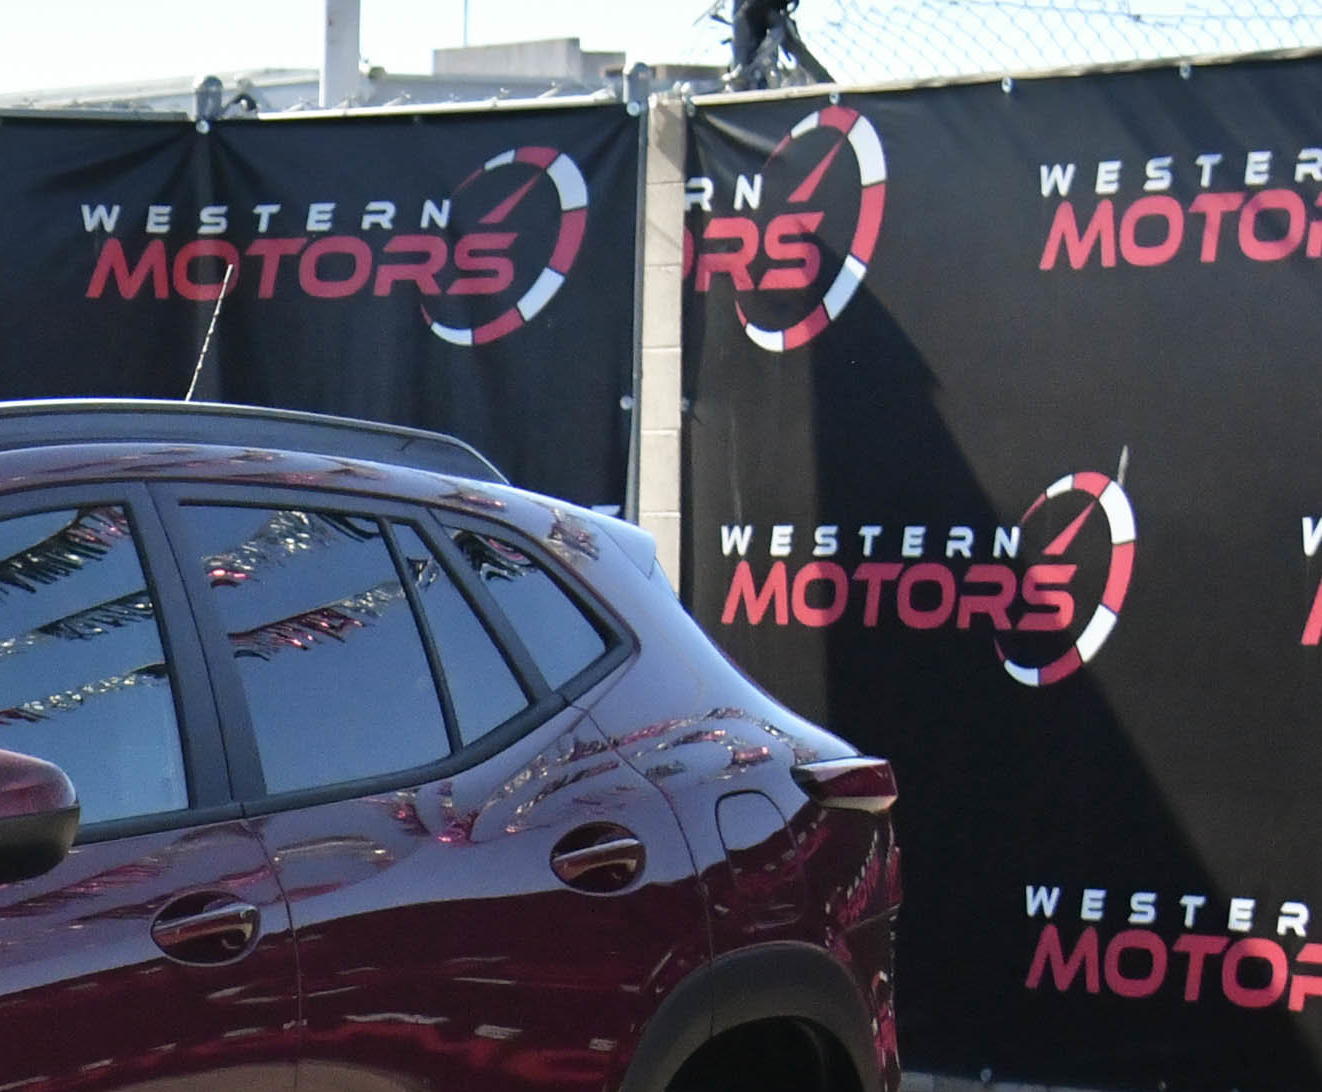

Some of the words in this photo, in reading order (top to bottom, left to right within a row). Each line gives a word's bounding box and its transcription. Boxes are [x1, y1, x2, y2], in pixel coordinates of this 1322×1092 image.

[81, 199, 452, 235] WESTERN
[682, 211, 825, 292] RS
[1039, 188, 1322, 271] MOTO
[86, 232, 518, 300] MOTORS
[720, 524, 1021, 558] WESTERN
[721, 559, 1078, 631] MOTORS
